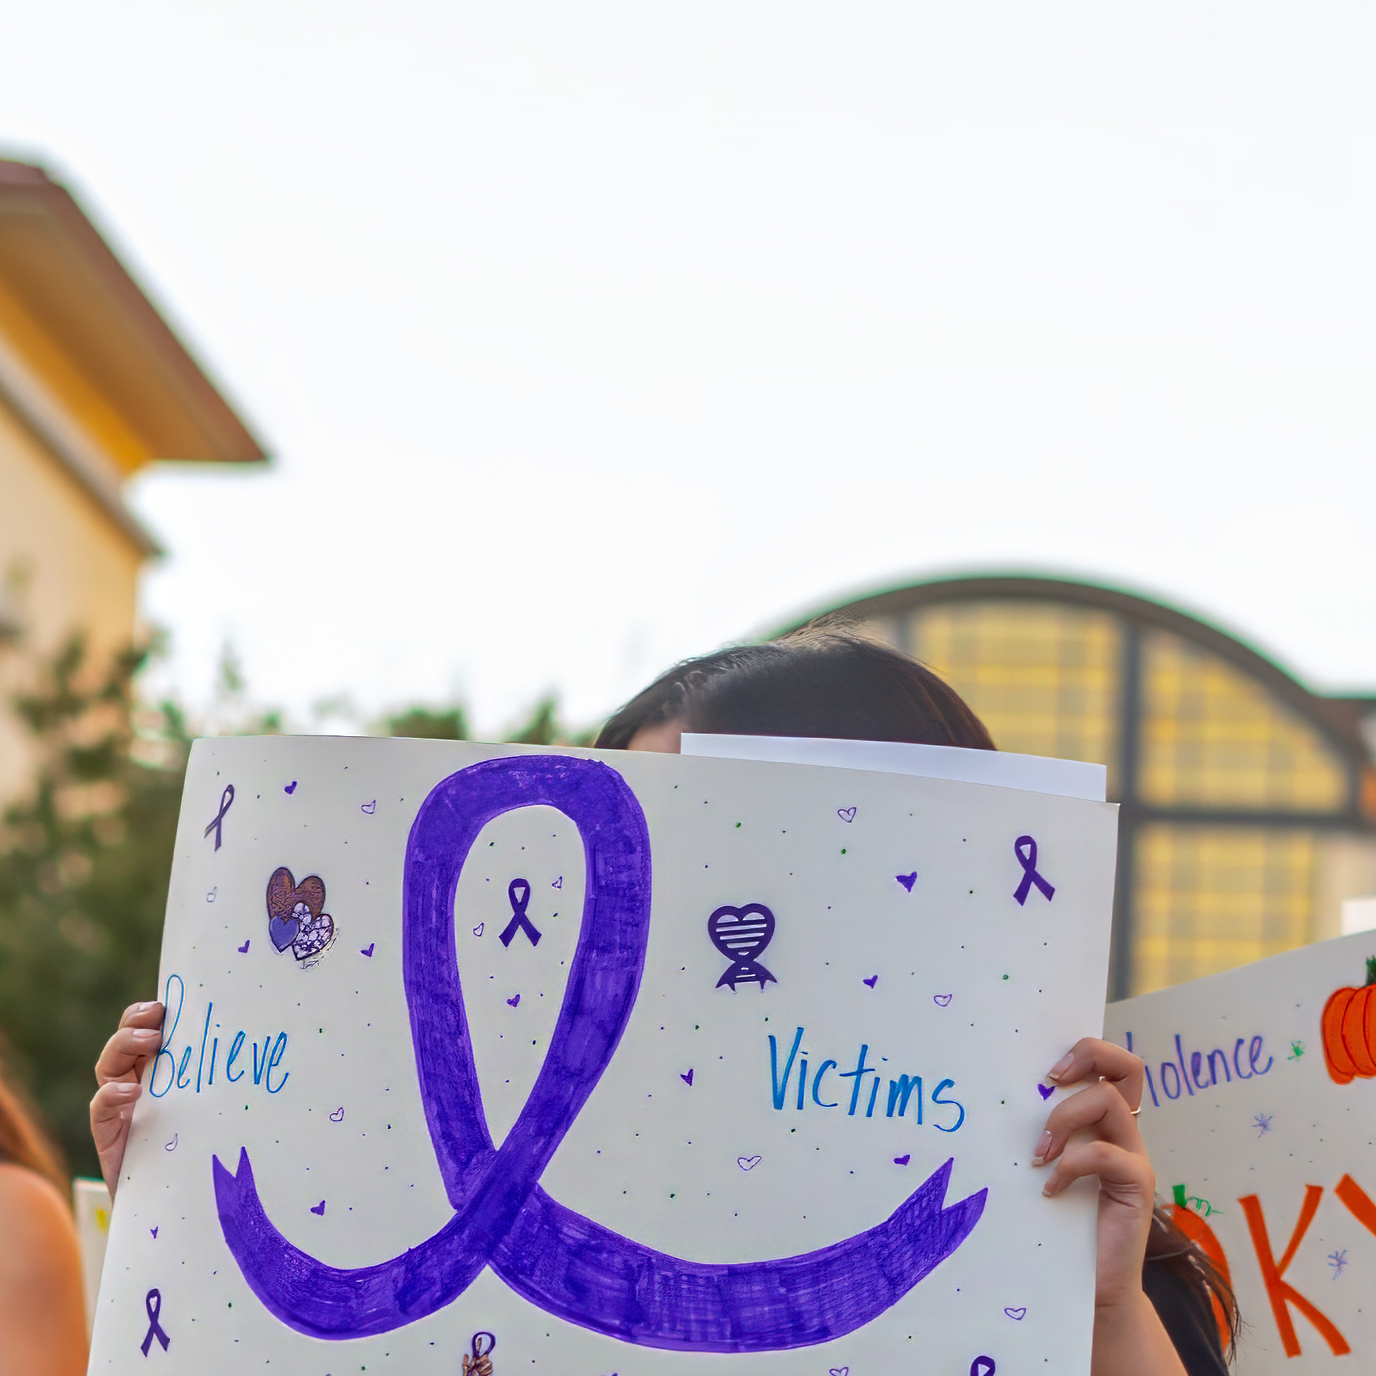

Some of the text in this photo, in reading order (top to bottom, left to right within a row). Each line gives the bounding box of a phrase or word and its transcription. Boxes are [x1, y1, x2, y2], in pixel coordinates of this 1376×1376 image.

[150, 974, 966, 1133] Believe Victims
[1125, 1031, 1274, 1108] iolence
